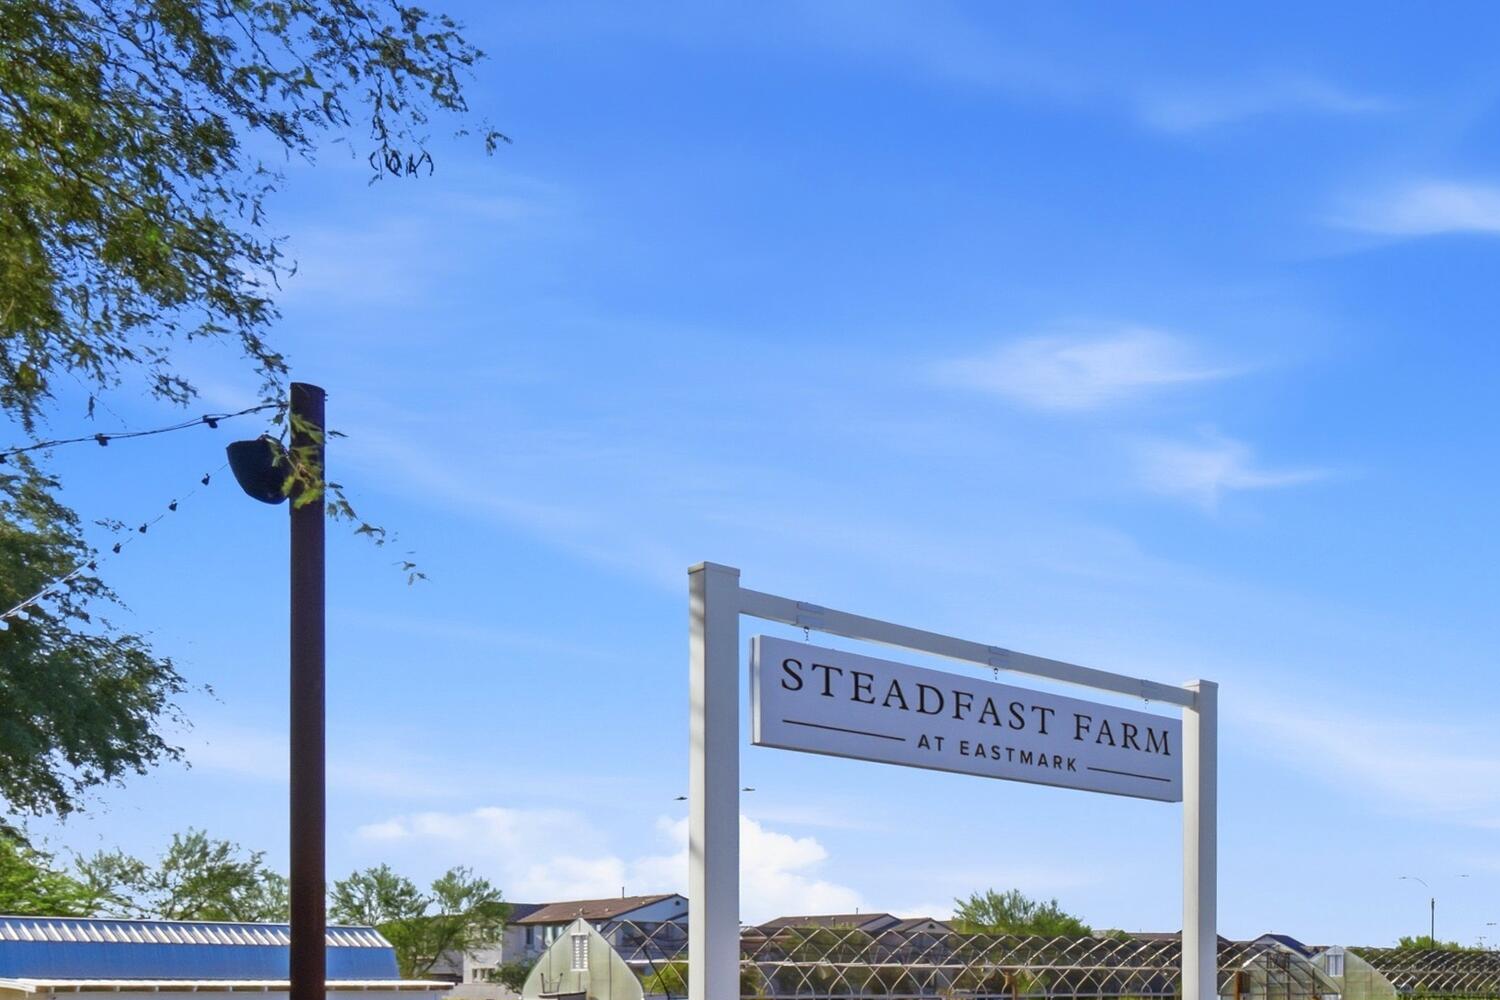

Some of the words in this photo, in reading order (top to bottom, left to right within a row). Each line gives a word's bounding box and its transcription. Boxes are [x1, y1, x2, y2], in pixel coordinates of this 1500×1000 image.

[781, 658, 1055, 735] STEADFAST
[1073, 713, 1171, 756] FARM
[917, 734, 945, 752] AT
[959, 741, 1077, 772] EASTMARK
